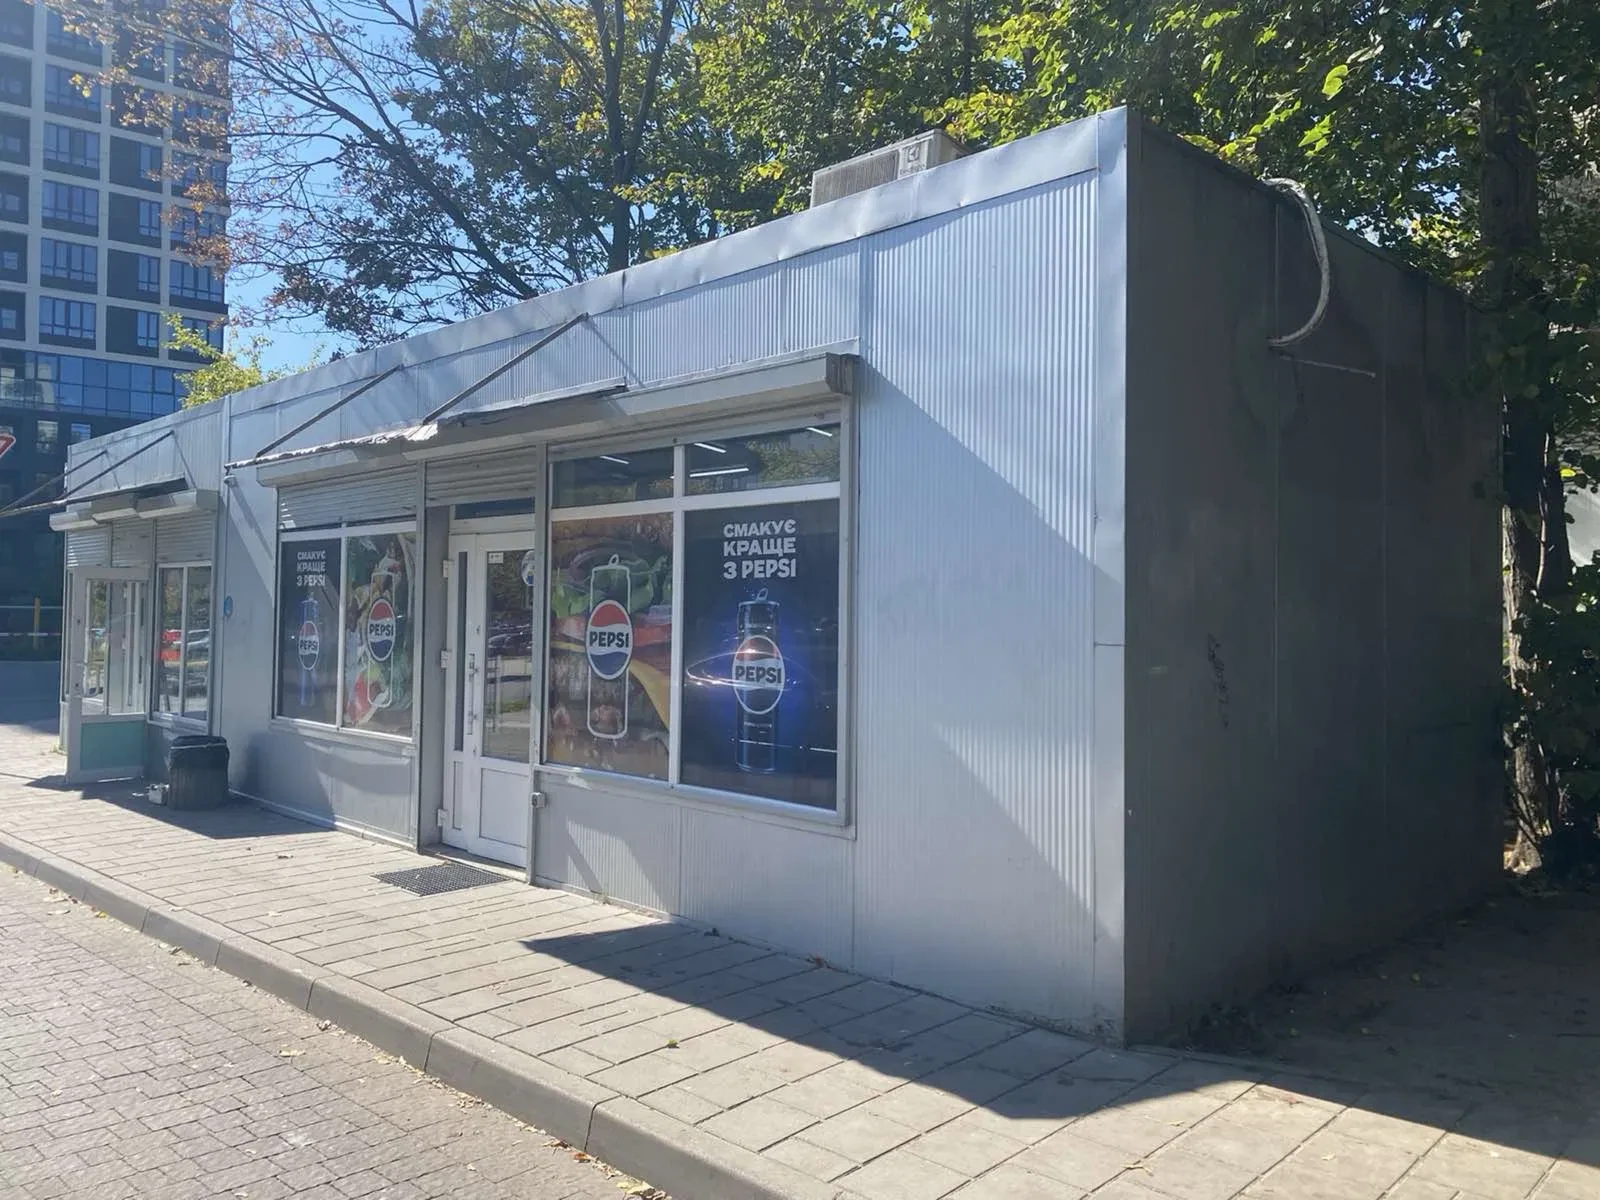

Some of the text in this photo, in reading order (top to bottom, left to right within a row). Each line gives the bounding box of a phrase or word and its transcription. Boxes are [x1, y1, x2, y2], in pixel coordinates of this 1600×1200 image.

[723, 519, 796, 537] СМАКУЄ
[723, 537, 796, 557] КРАЩЕ
[296, 561, 326, 573] КРАЩЕ
[741, 558, 796, 578] PEPSI
[303, 574, 325, 586] PEPSI
[369, 623, 394, 636] PEPSI
[299, 640, 319, 650] PEPSI
[589, 631, 629, 648] PEPSI
[735, 665, 782, 683] PEPSI
